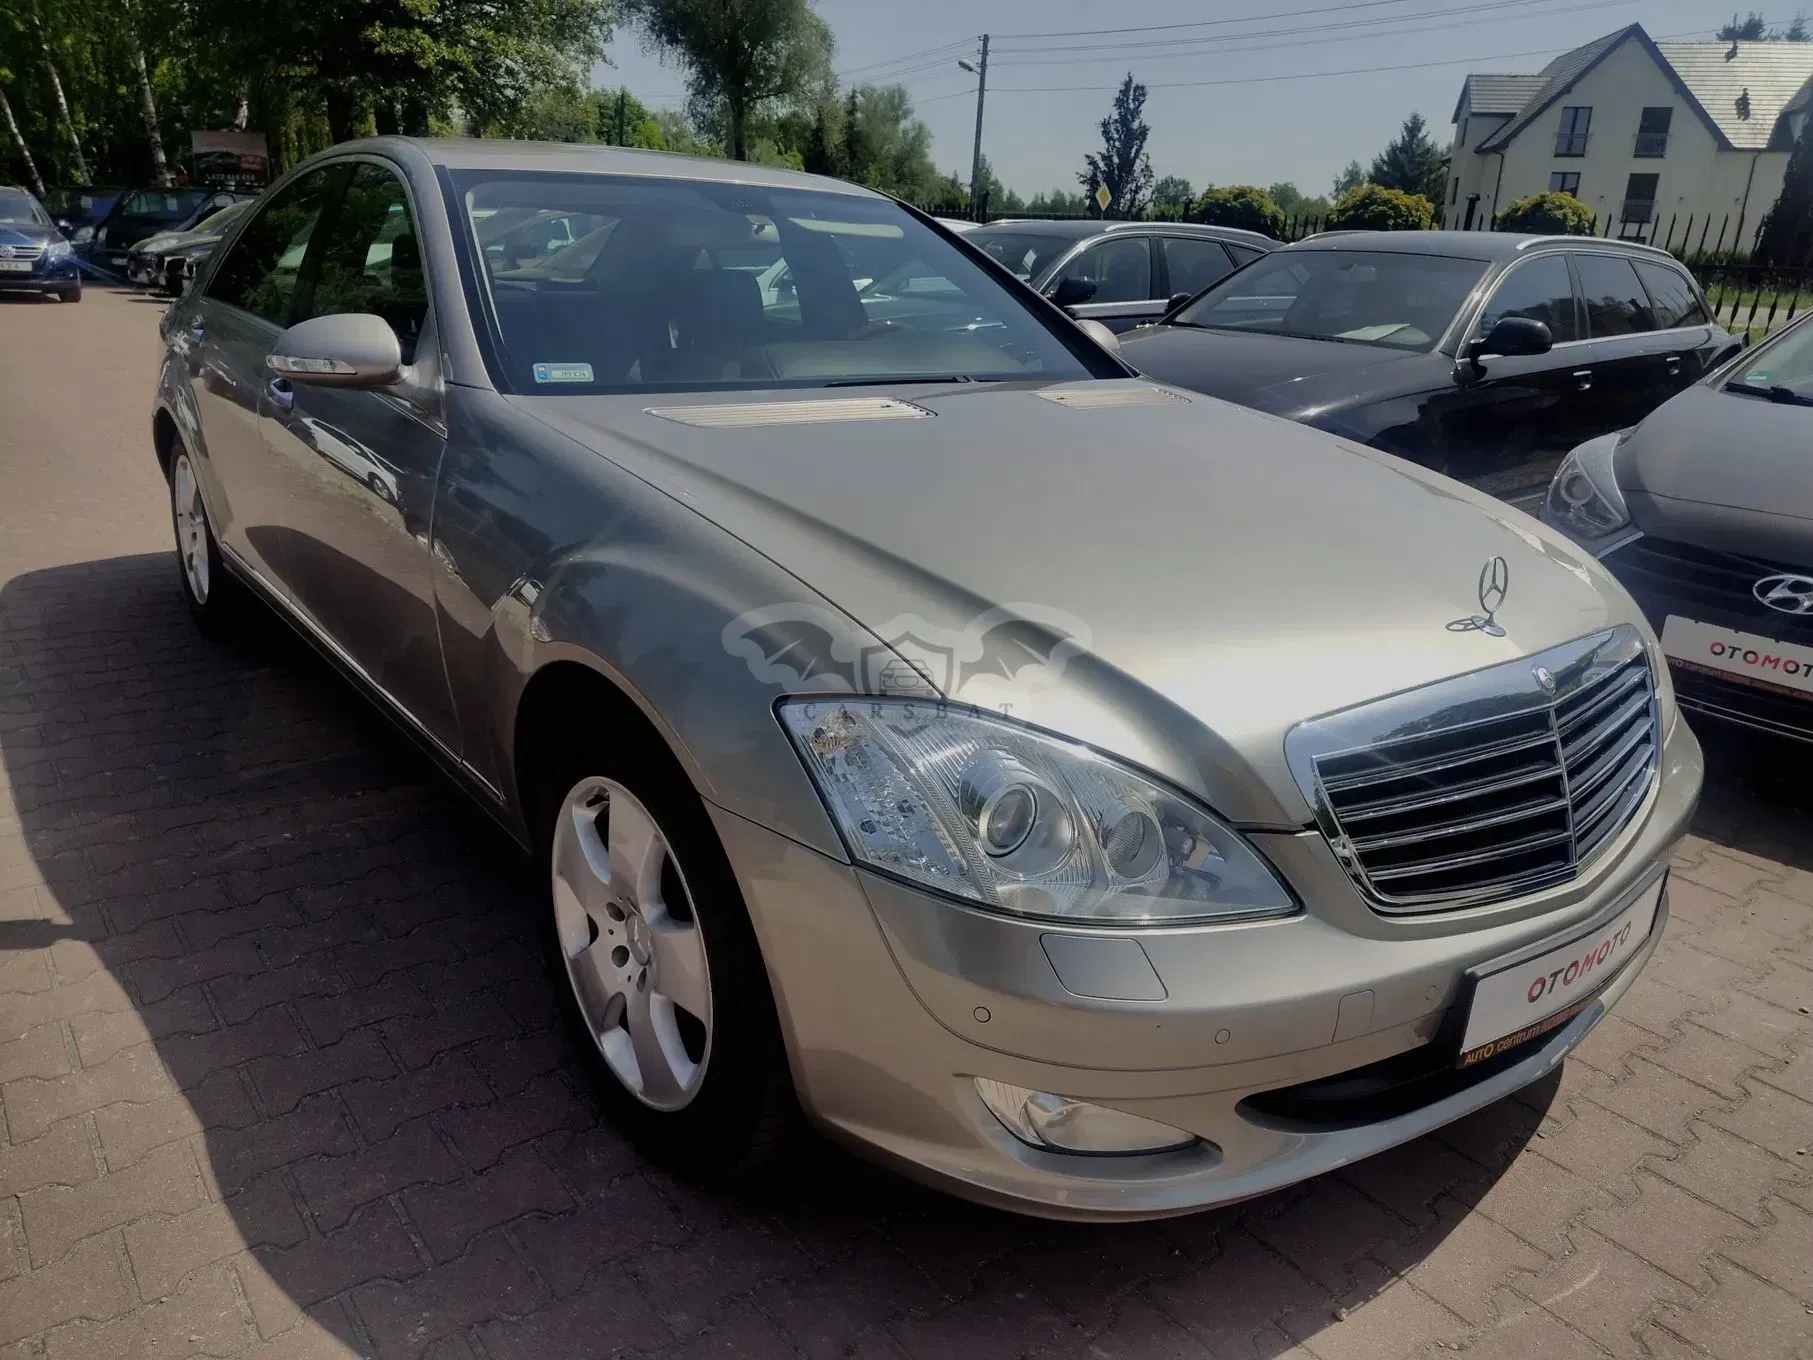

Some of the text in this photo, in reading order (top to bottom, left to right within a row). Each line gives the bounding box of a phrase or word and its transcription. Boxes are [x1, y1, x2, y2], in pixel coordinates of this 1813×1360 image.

[1527, 920, 1632, 1003] OTOMOTO
[1464, 1027, 1540, 1065] AUTO centrum
